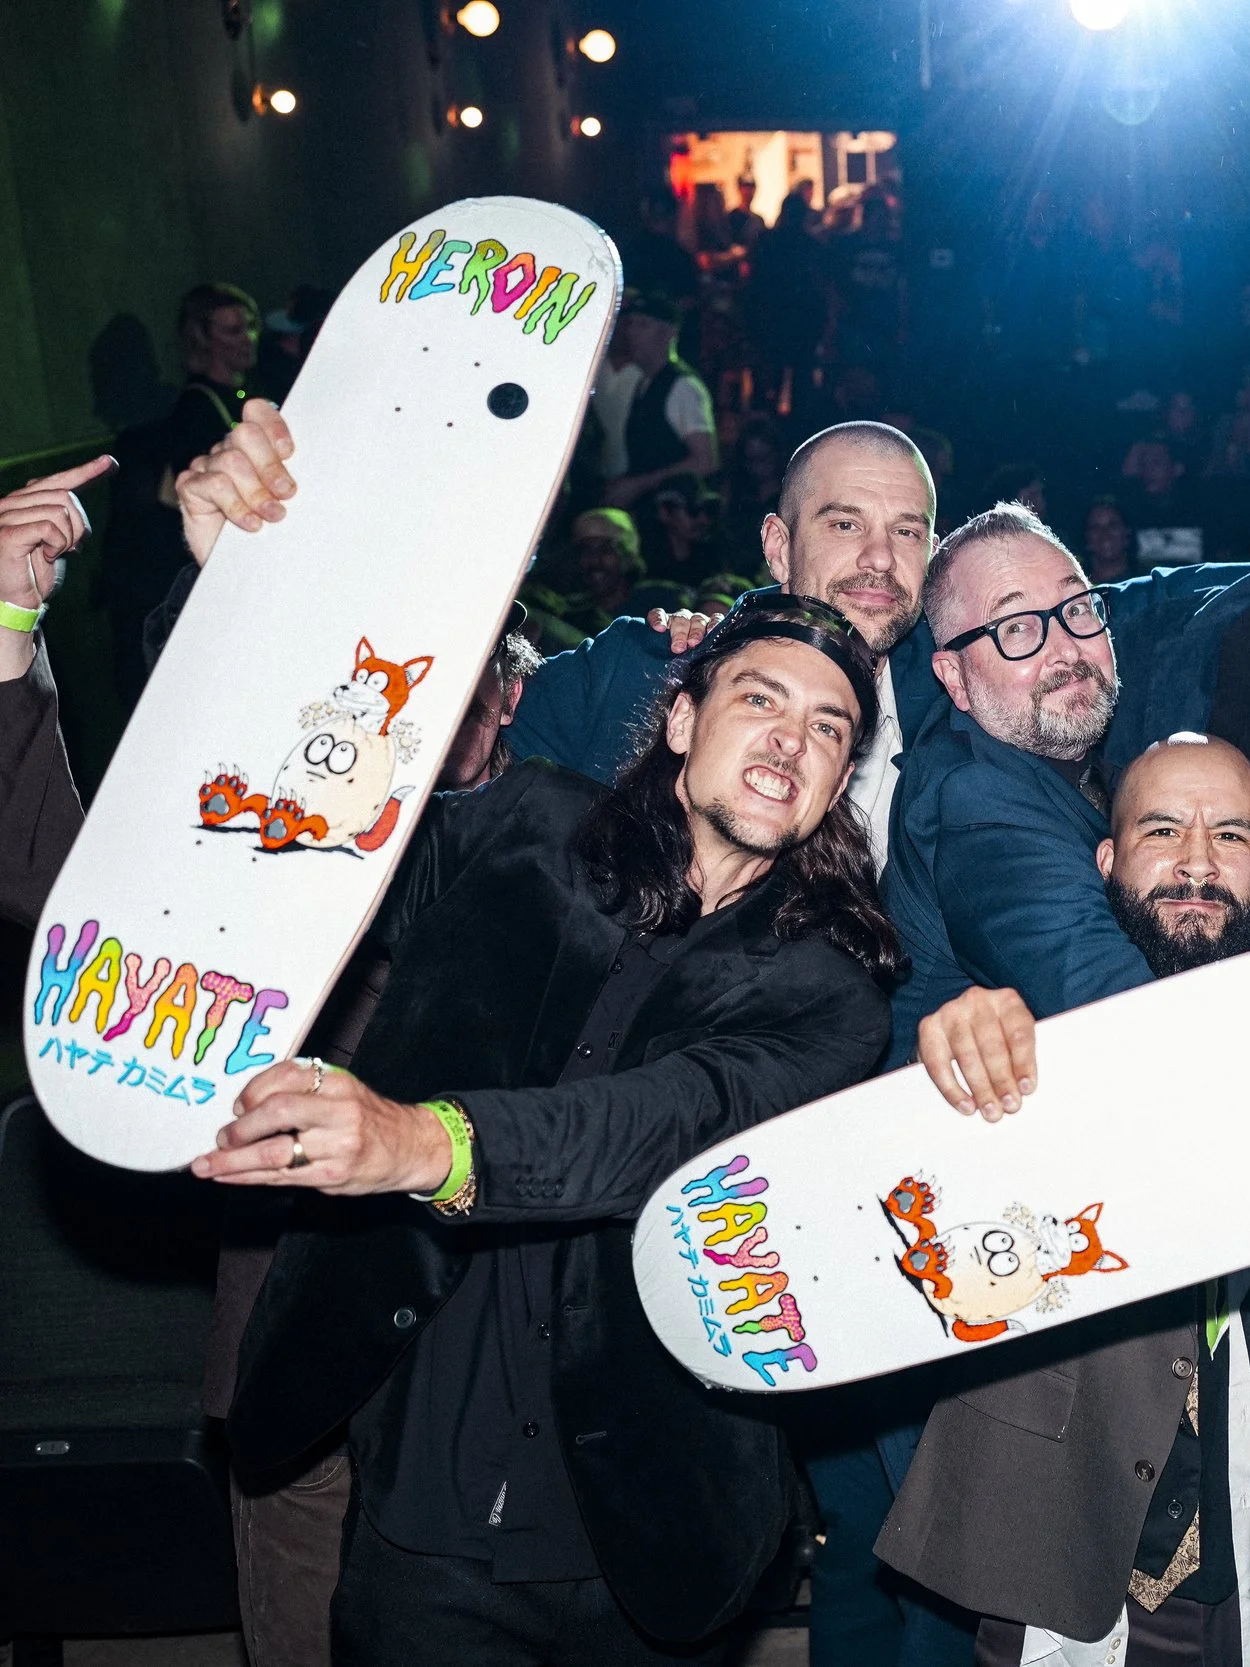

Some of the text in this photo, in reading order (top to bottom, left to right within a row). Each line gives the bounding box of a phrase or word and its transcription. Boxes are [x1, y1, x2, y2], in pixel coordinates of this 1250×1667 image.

[379, 229, 597, 345] HEROIN
[34, 920, 289, 1075] HAYATE
[680, 1155, 818, 1387] HAYATE
